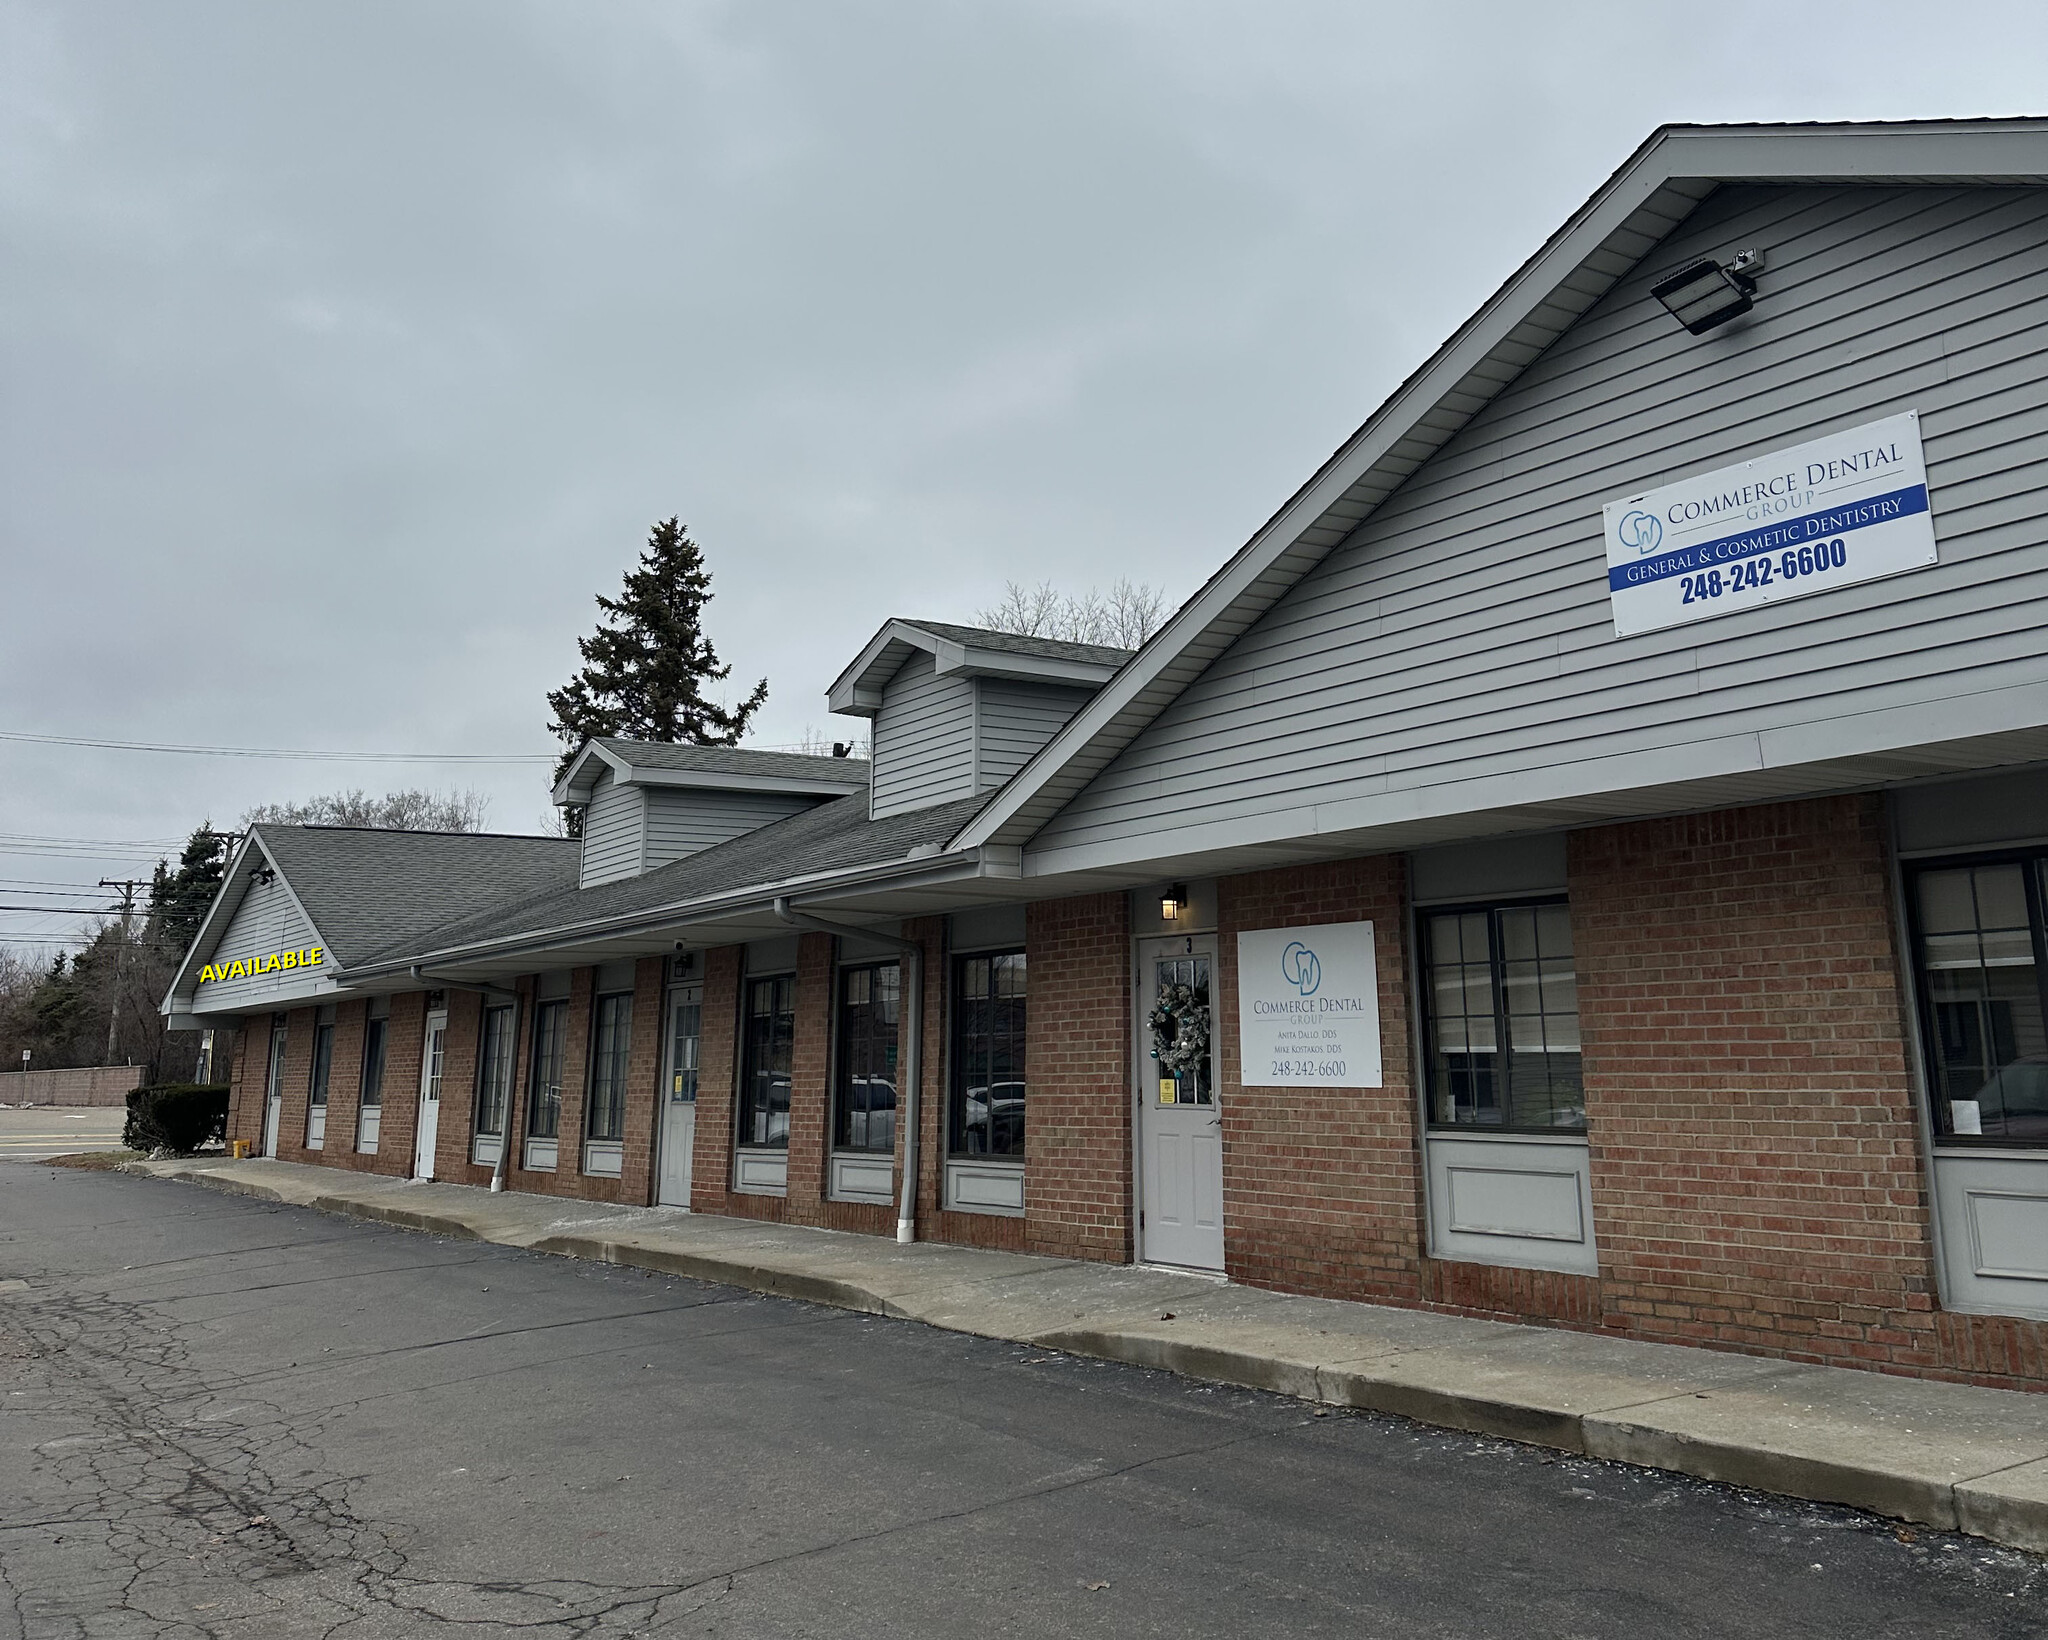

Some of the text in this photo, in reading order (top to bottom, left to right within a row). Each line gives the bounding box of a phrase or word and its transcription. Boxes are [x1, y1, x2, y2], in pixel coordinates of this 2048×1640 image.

[1668, 443, 1903, 525] COMMERCE DENTAL
[1746, 490, 1815, 521] GROUP
[1627, 497, 1902, 583] GENERAL & COSMETIC DENTISTRY
[1680, 538, 1847, 604] 248-242-6600
[1186, 937, 1192, 953] 3
[1253, 998, 1364, 1015] COMMERCE DENTAL
[1290, 1014, 1324, 1025] GROUP
[1278, 1031, 1297, 1039] ANITA
[1322, 1030, 1337, 1039] DDS
[1326, 1045, 1342, 1053] DDS
[1271, 1060, 1346, 1077] 248-242-6600
